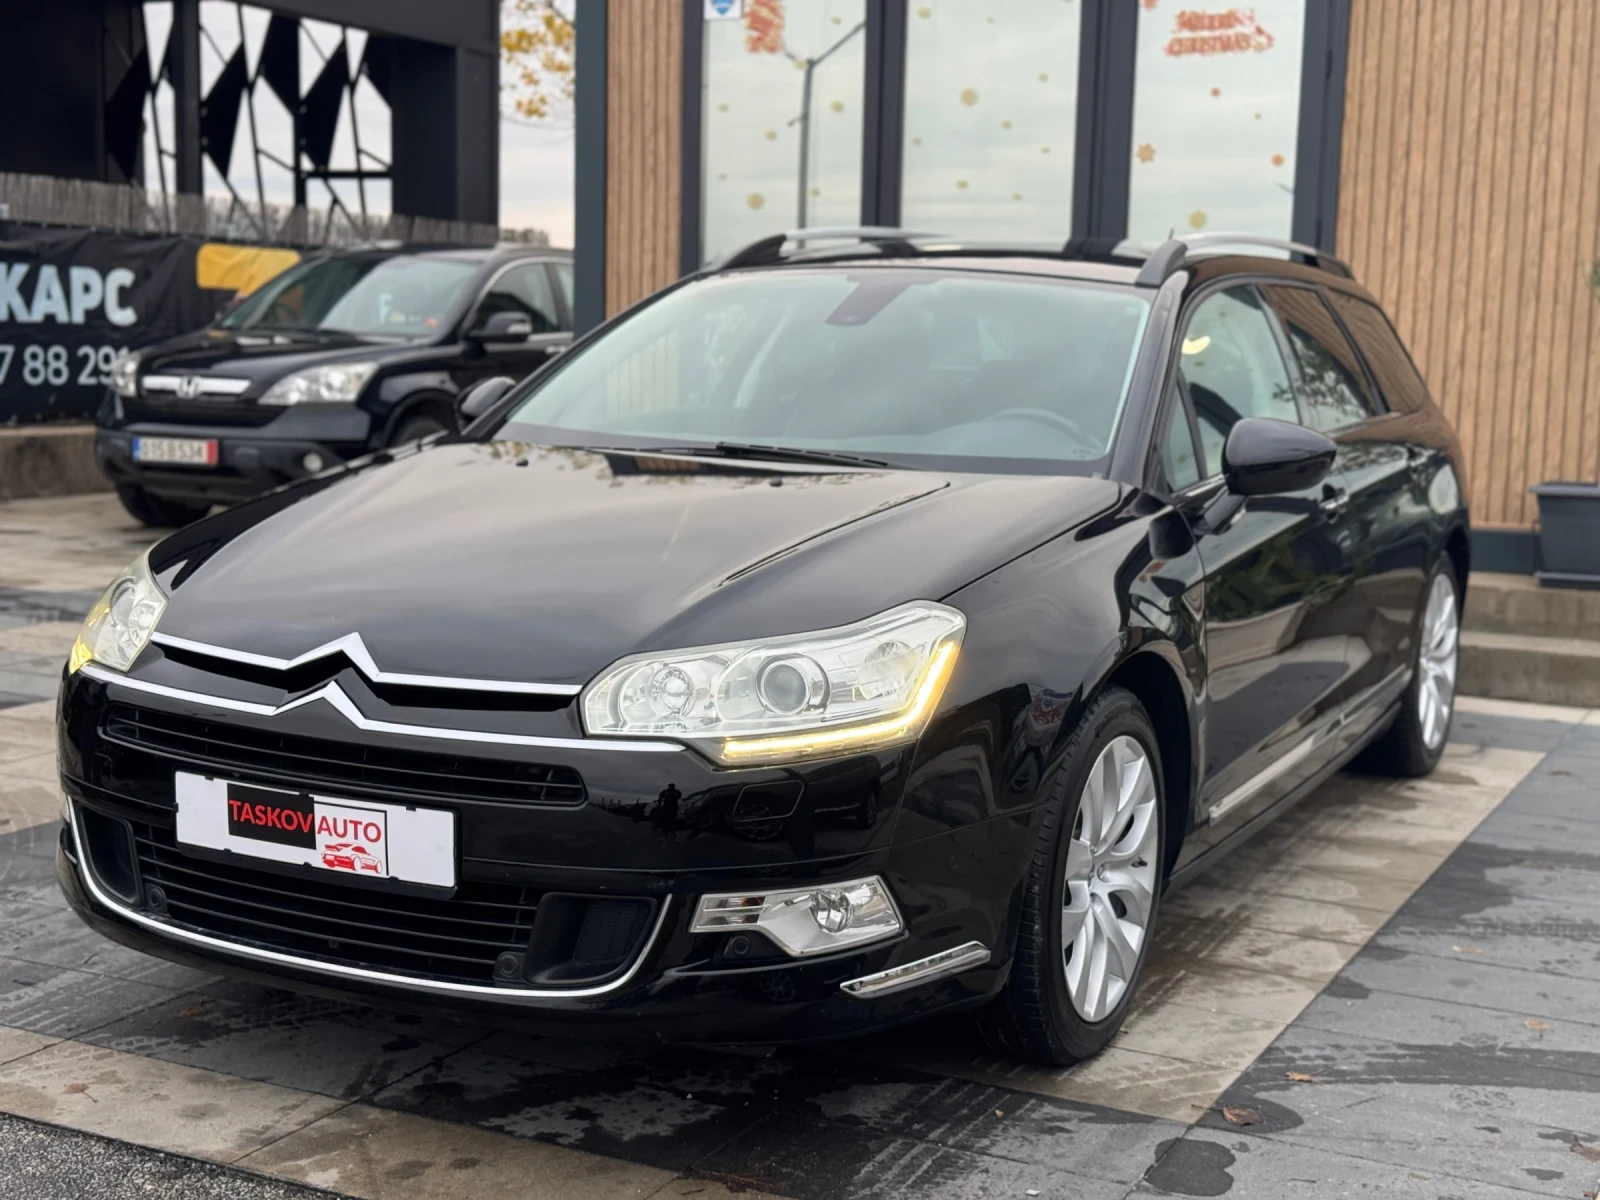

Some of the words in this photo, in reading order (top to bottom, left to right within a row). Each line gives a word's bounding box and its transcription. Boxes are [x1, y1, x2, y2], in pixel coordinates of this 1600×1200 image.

[22, 344, 70, 386] 88
[76, 344, 130, 386] 29
[228, 799, 314, 834] TASKOV
[316, 815, 383, 844] AUTO
